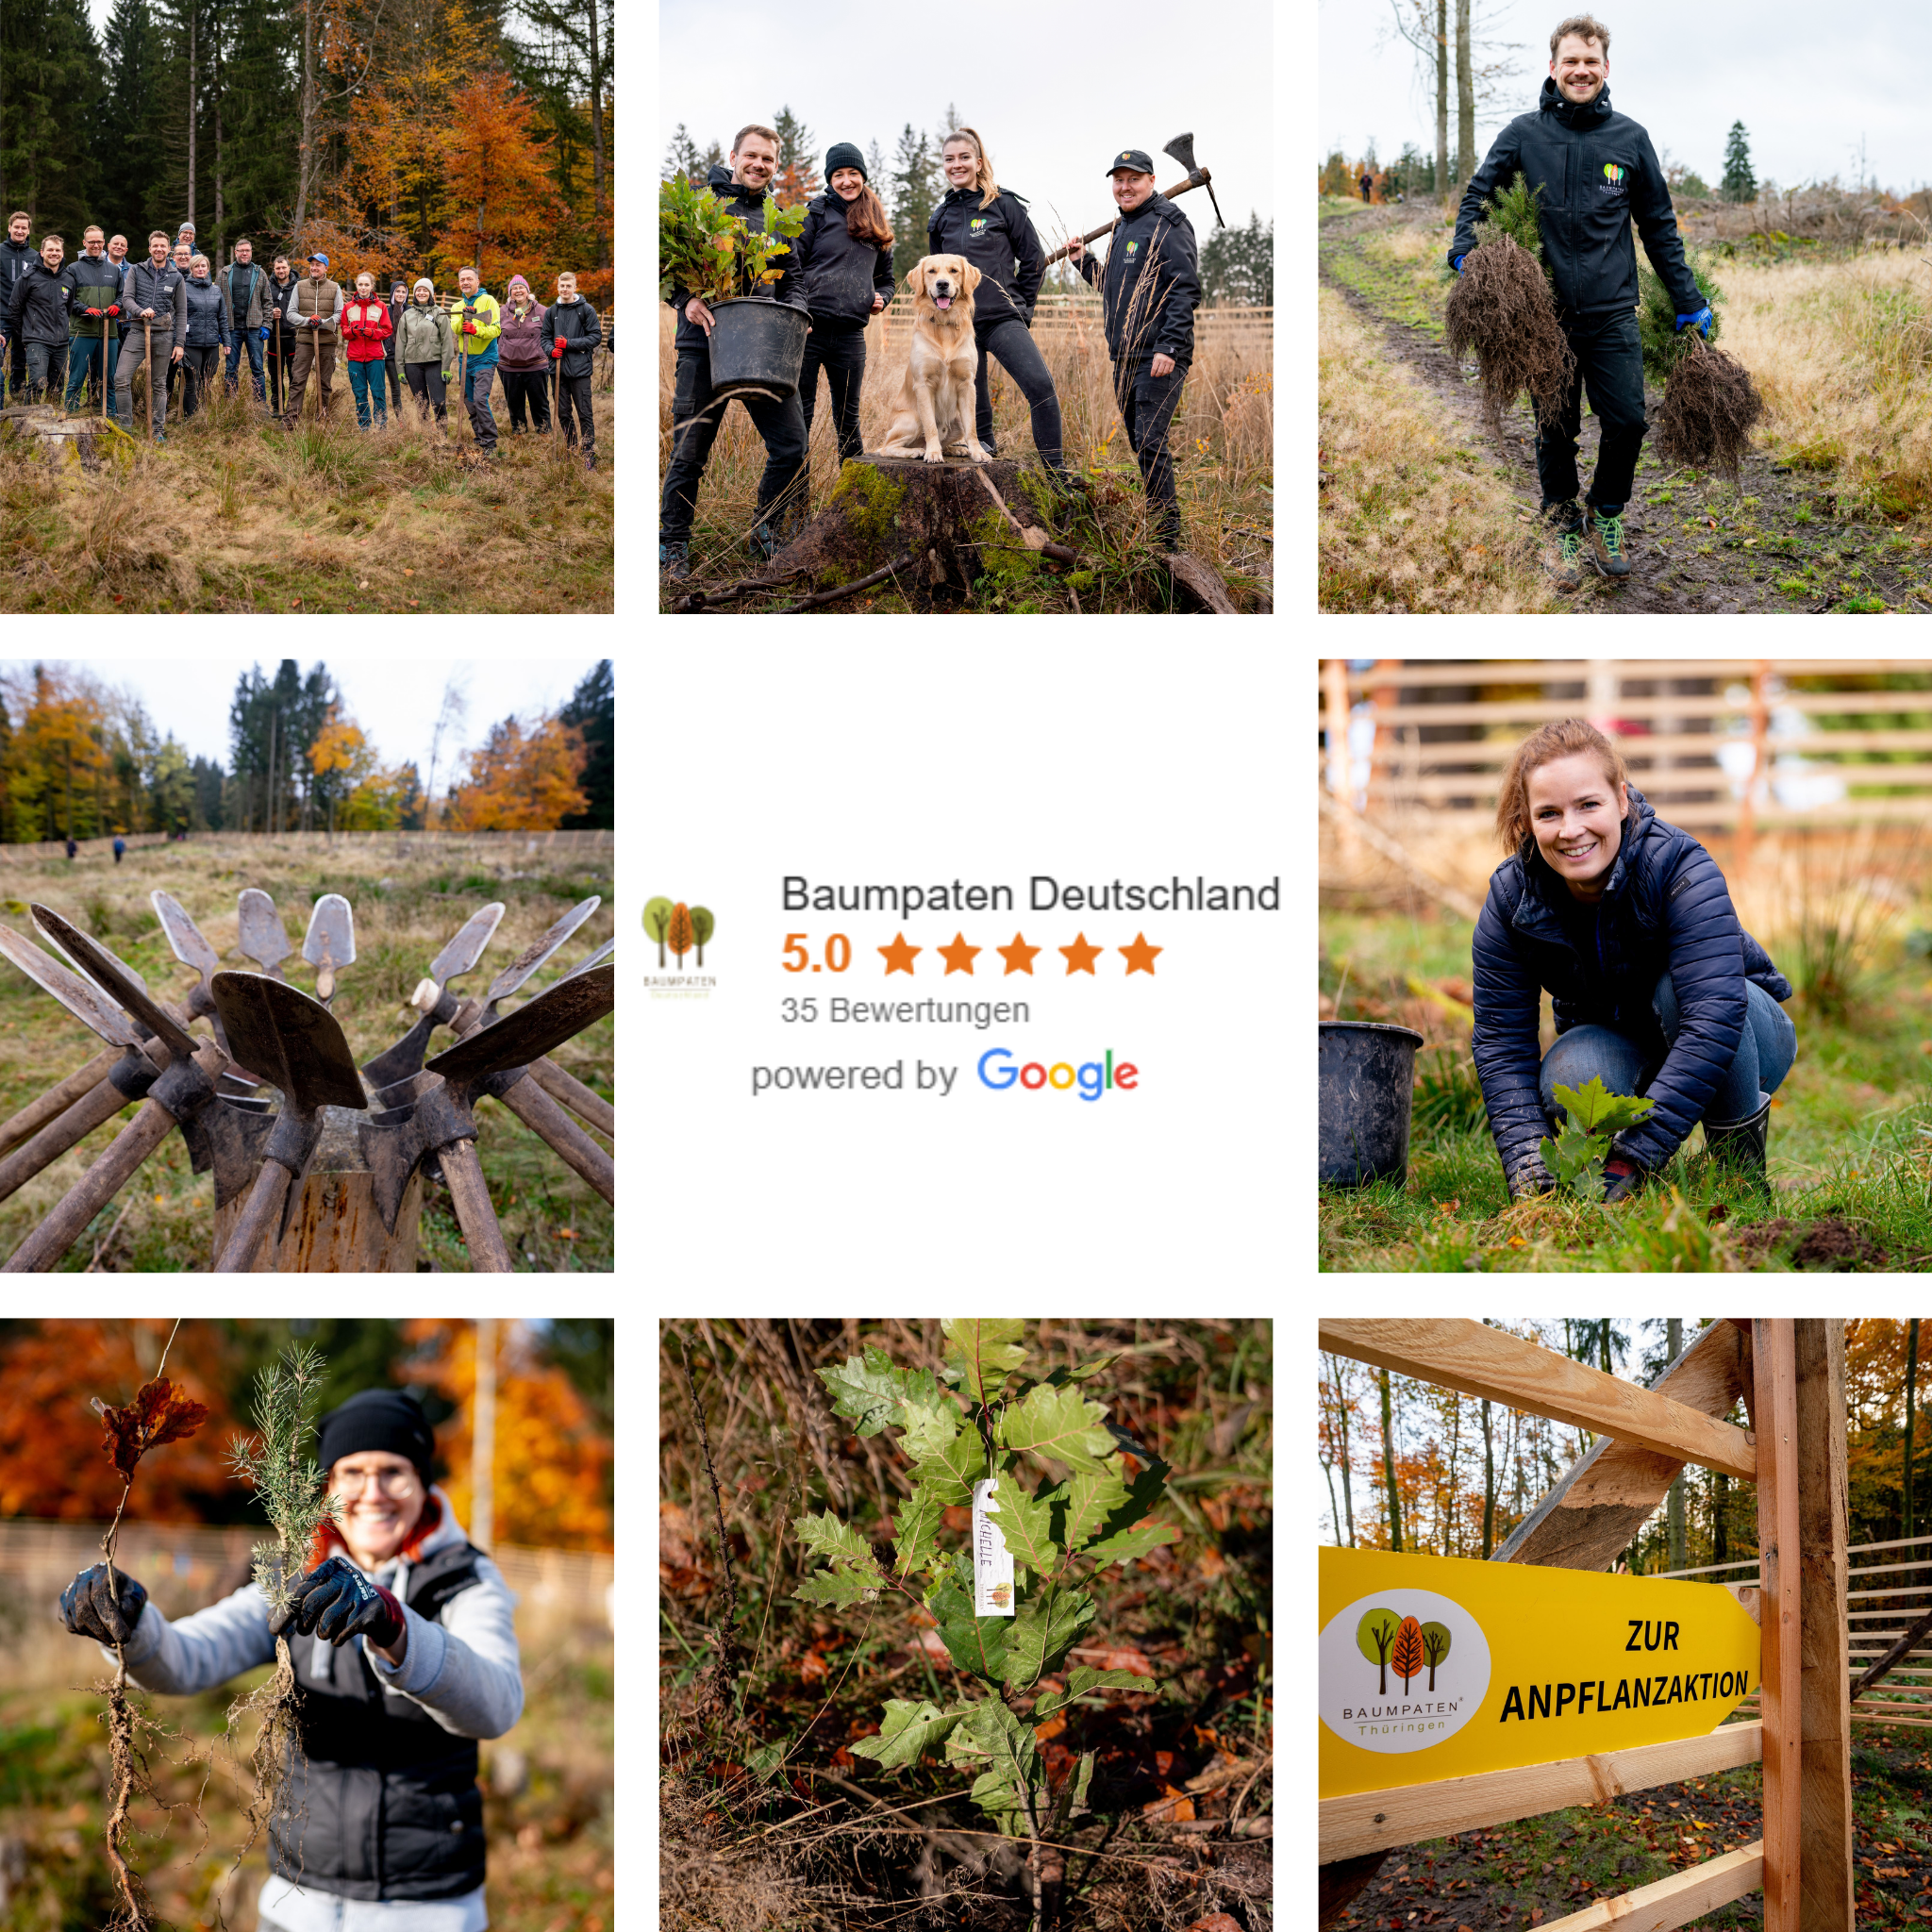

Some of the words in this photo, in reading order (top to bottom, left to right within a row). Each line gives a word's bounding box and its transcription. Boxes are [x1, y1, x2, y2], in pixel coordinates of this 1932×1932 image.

[353, 1574, 368, 1600] Garant
[1625, 1620, 1680, 1652] ZUR
[1499, 1670, 1749, 1724] ANPFLANZAKTION
[1342, 1702, 1458, 1720] BAUMPATEN
[1358, 1721, 1445, 1736] Thüringen
